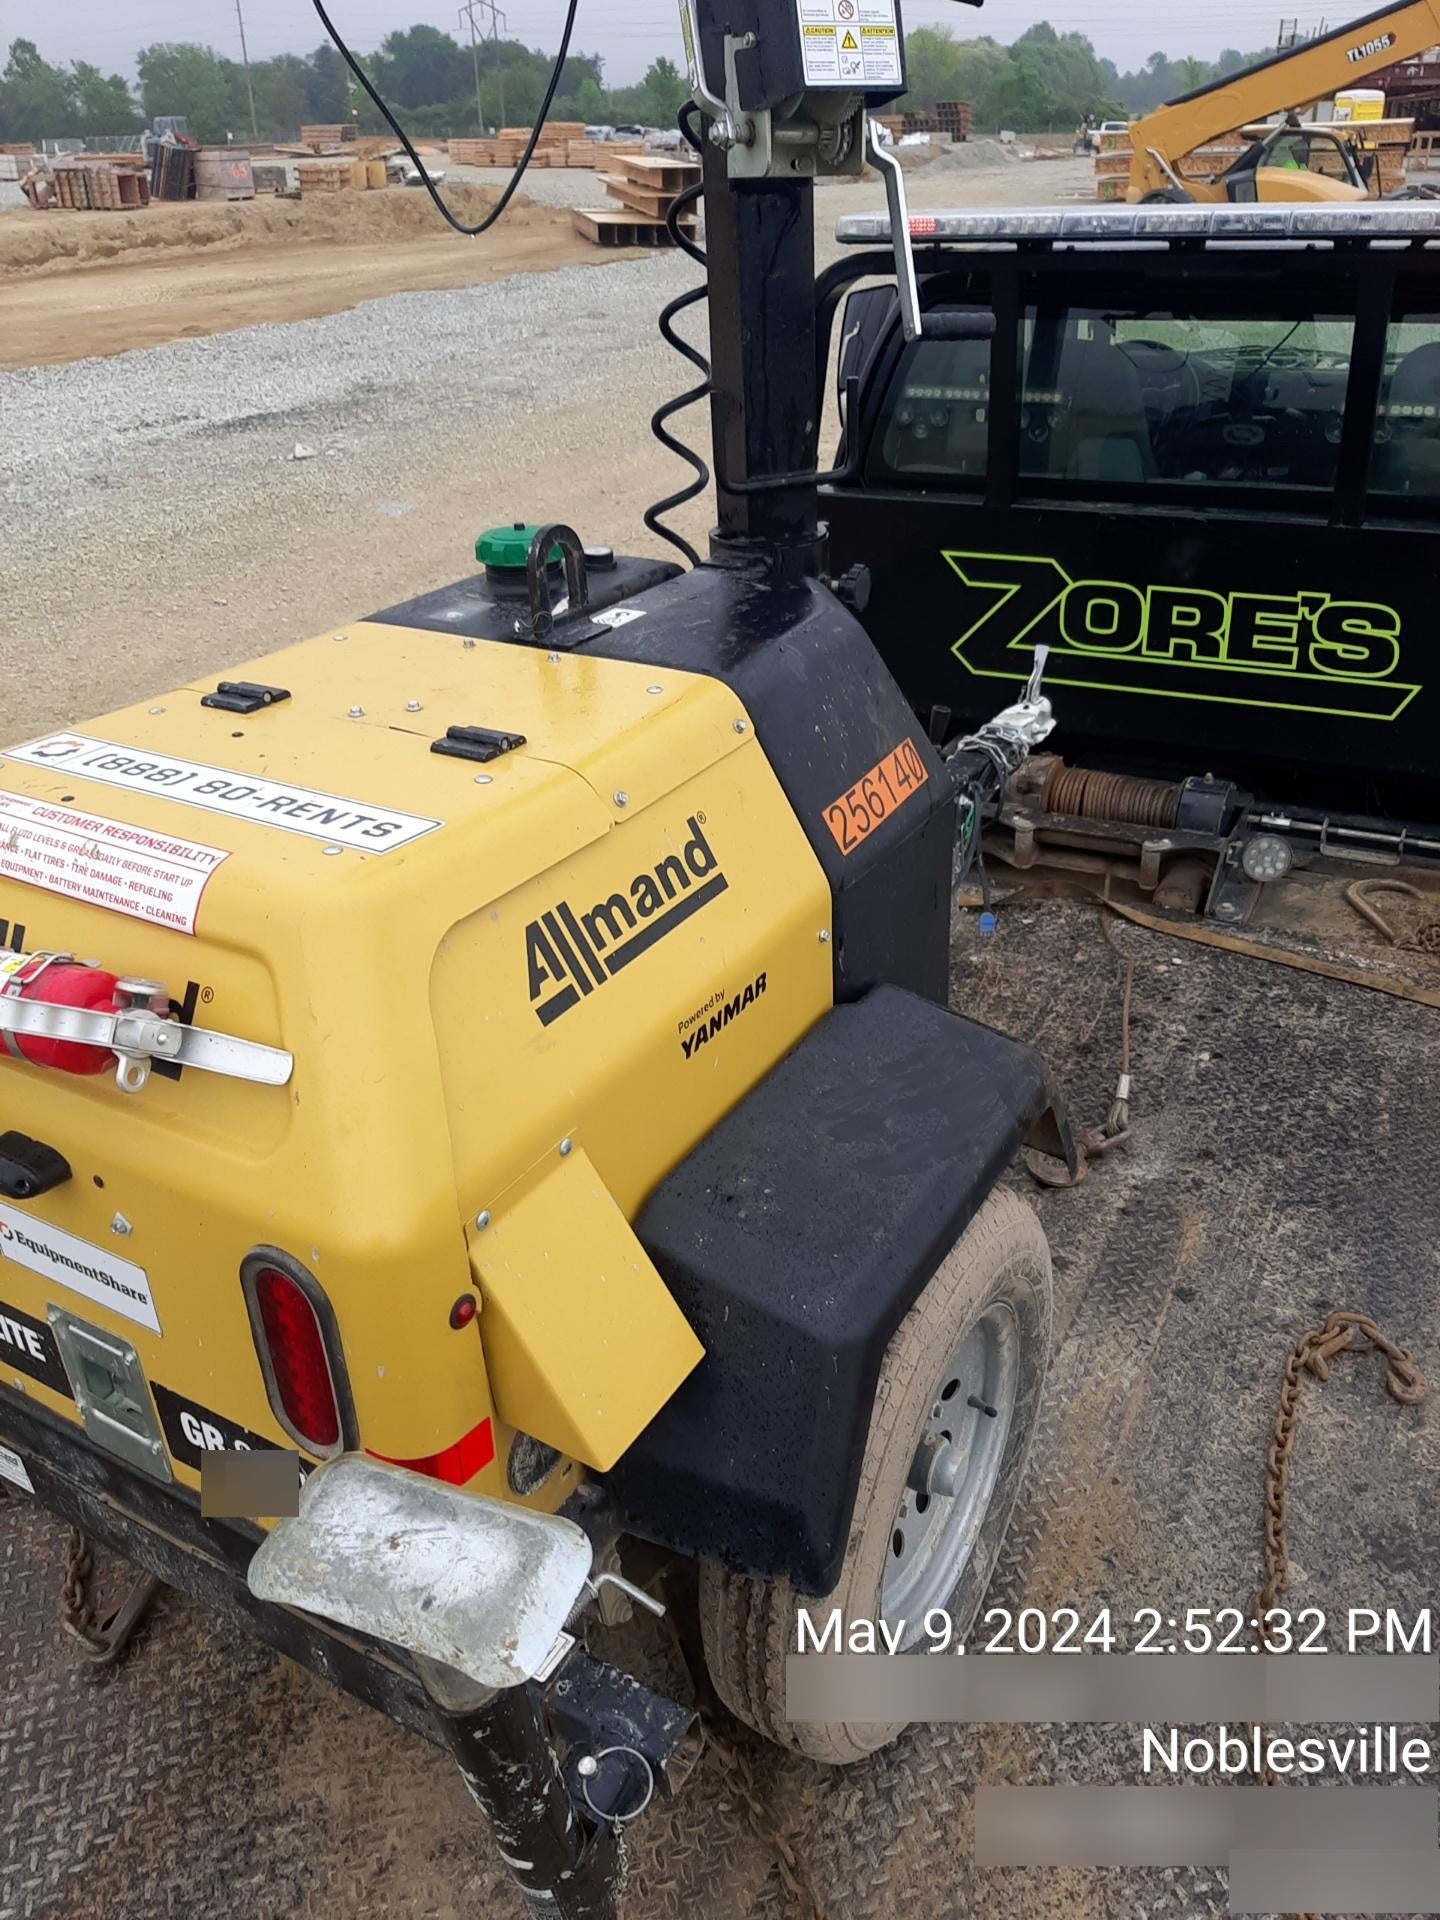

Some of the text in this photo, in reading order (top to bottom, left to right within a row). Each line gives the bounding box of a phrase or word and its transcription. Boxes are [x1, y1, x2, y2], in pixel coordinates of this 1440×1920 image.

[1346, 34, 1391, 62] TL1055
[940, 549, 1422, 720] ZORE'S
[83, 753, 402, 839] (888) 80-RENTS
[829, 741, 924, 850] 256140
[10, 826, 33, 840] FLUID
[33, 832, 60, 847] LEVELS
[99, 852, 121, 867] DAILY
[121, 859, 153, 877] BEFORE
[153, 869, 179, 885] START
[180, 877, 193, 889] UP
[32, 806, 221, 866] CUSTOMER RESPONSIBILITY
[1, 858, 187, 927] EQUIPMENT BATTERY MAINTENANCE CLEANING
[24, 848, 42, 862] FLAT
[43, 853, 65, 869] TIRES
[71, 863, 89, 877] TIRE
[89, 868, 122, 887] DAMAGE
[128, 880, 173, 902] REFUELING
[677, 988, 725, 1034] Powered by
[681, 971, 768, 1060] YANMAR
[14, 1229, 148, 1305] EquipmentShare
[0, 1314, 47, 1363] ITE
